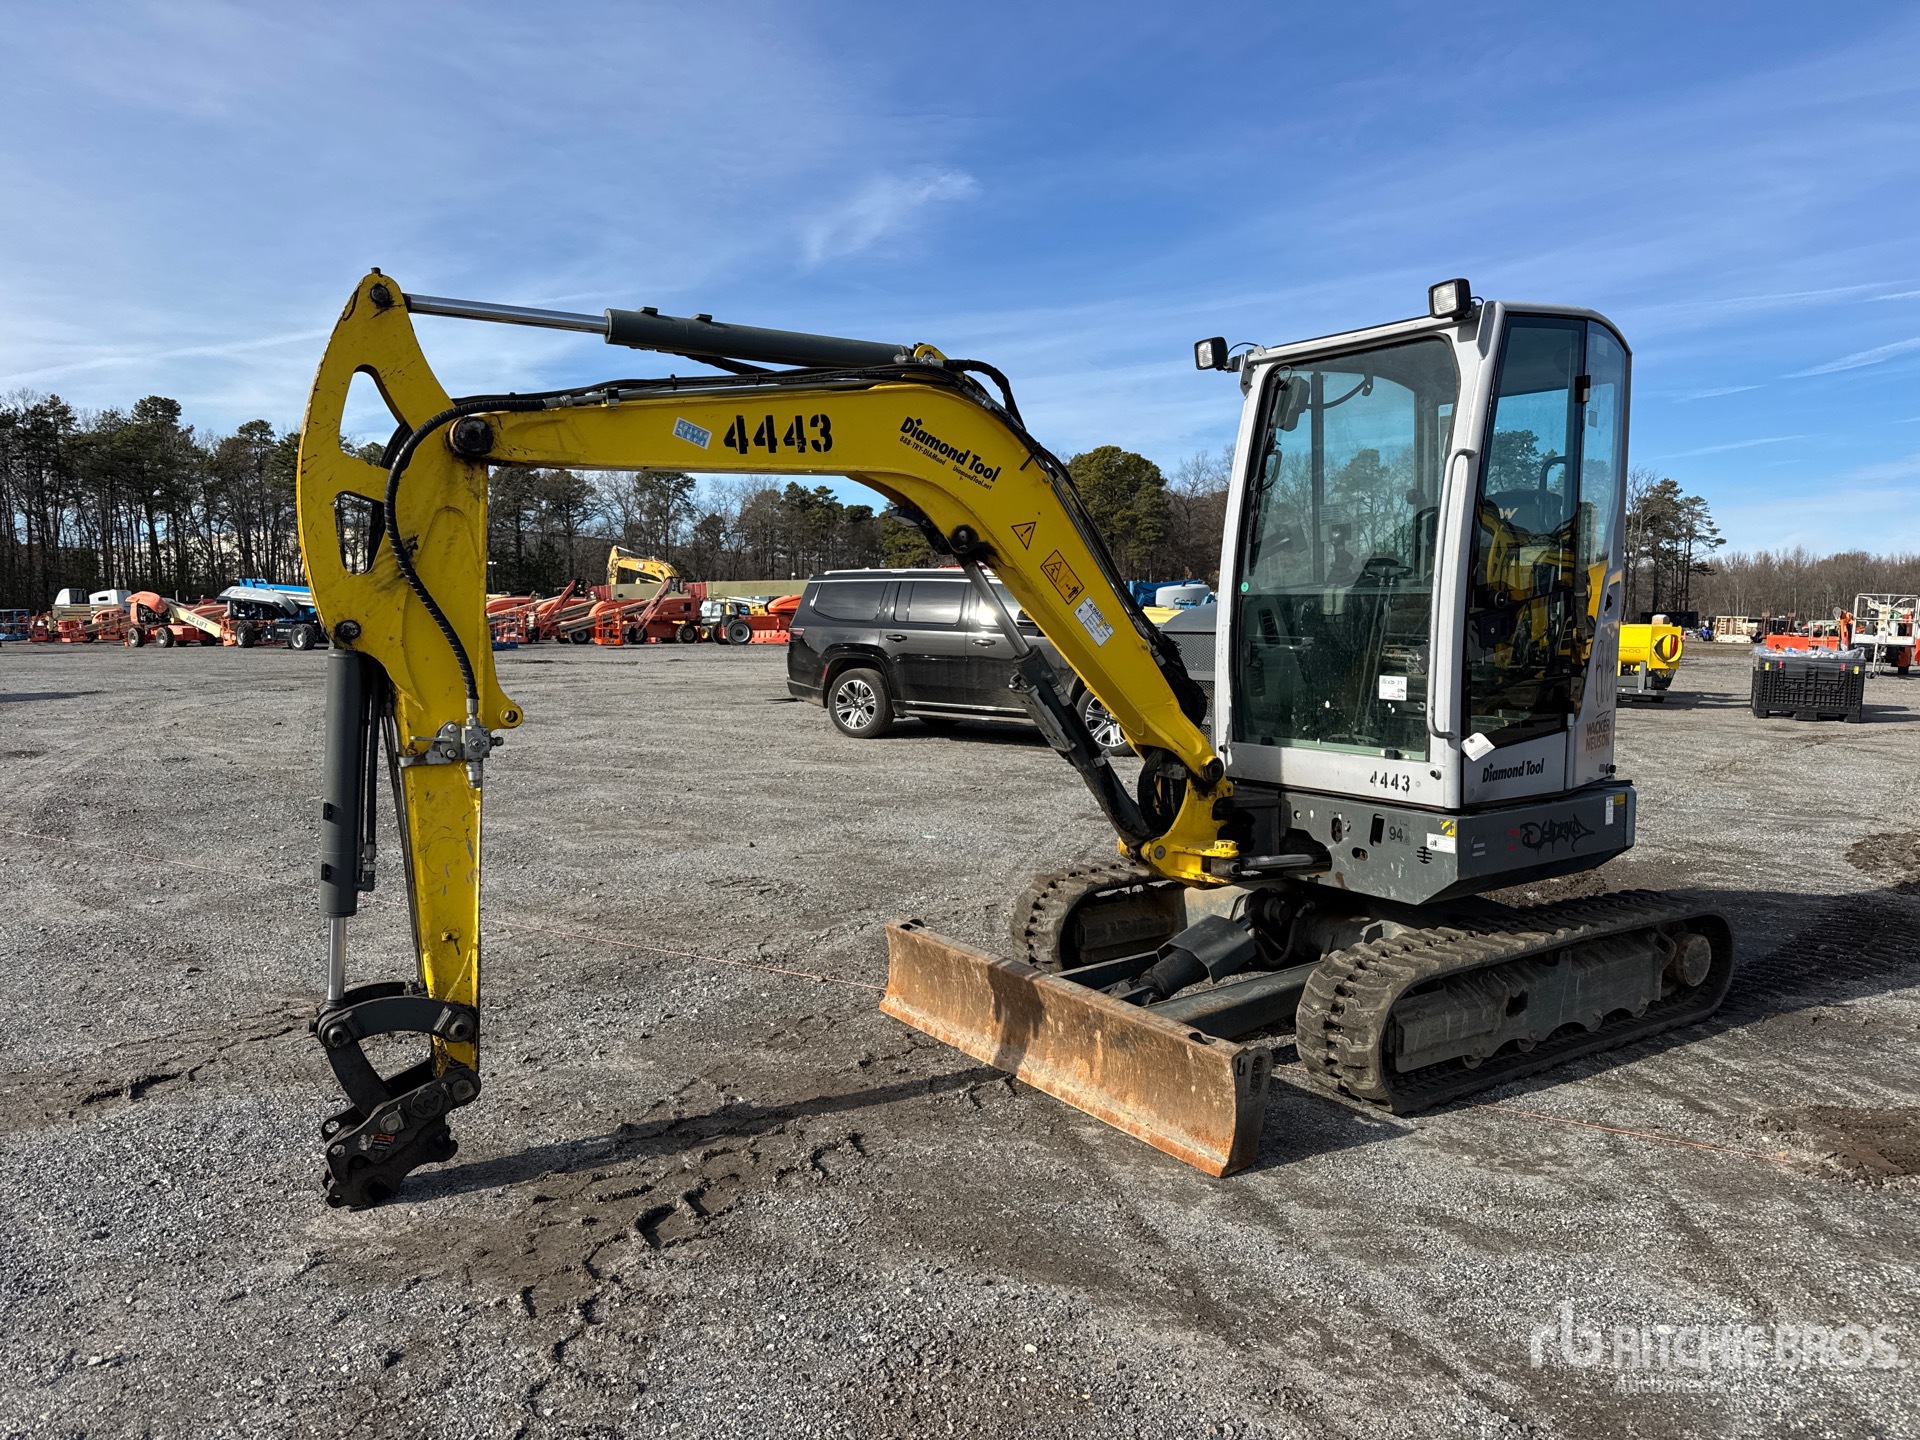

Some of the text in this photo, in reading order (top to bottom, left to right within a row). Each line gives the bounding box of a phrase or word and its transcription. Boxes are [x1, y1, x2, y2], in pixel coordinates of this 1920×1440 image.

[723, 414, 833, 455] 4443
[899, 416, 1002, 483] Diamond Tool
[1586, 719, 1610, 736] WACKER
[1586, 733, 1609, 752] NEUSON
[1369, 770, 1411, 793] 4443
[1482, 757, 1544, 783] Diamond Tool
